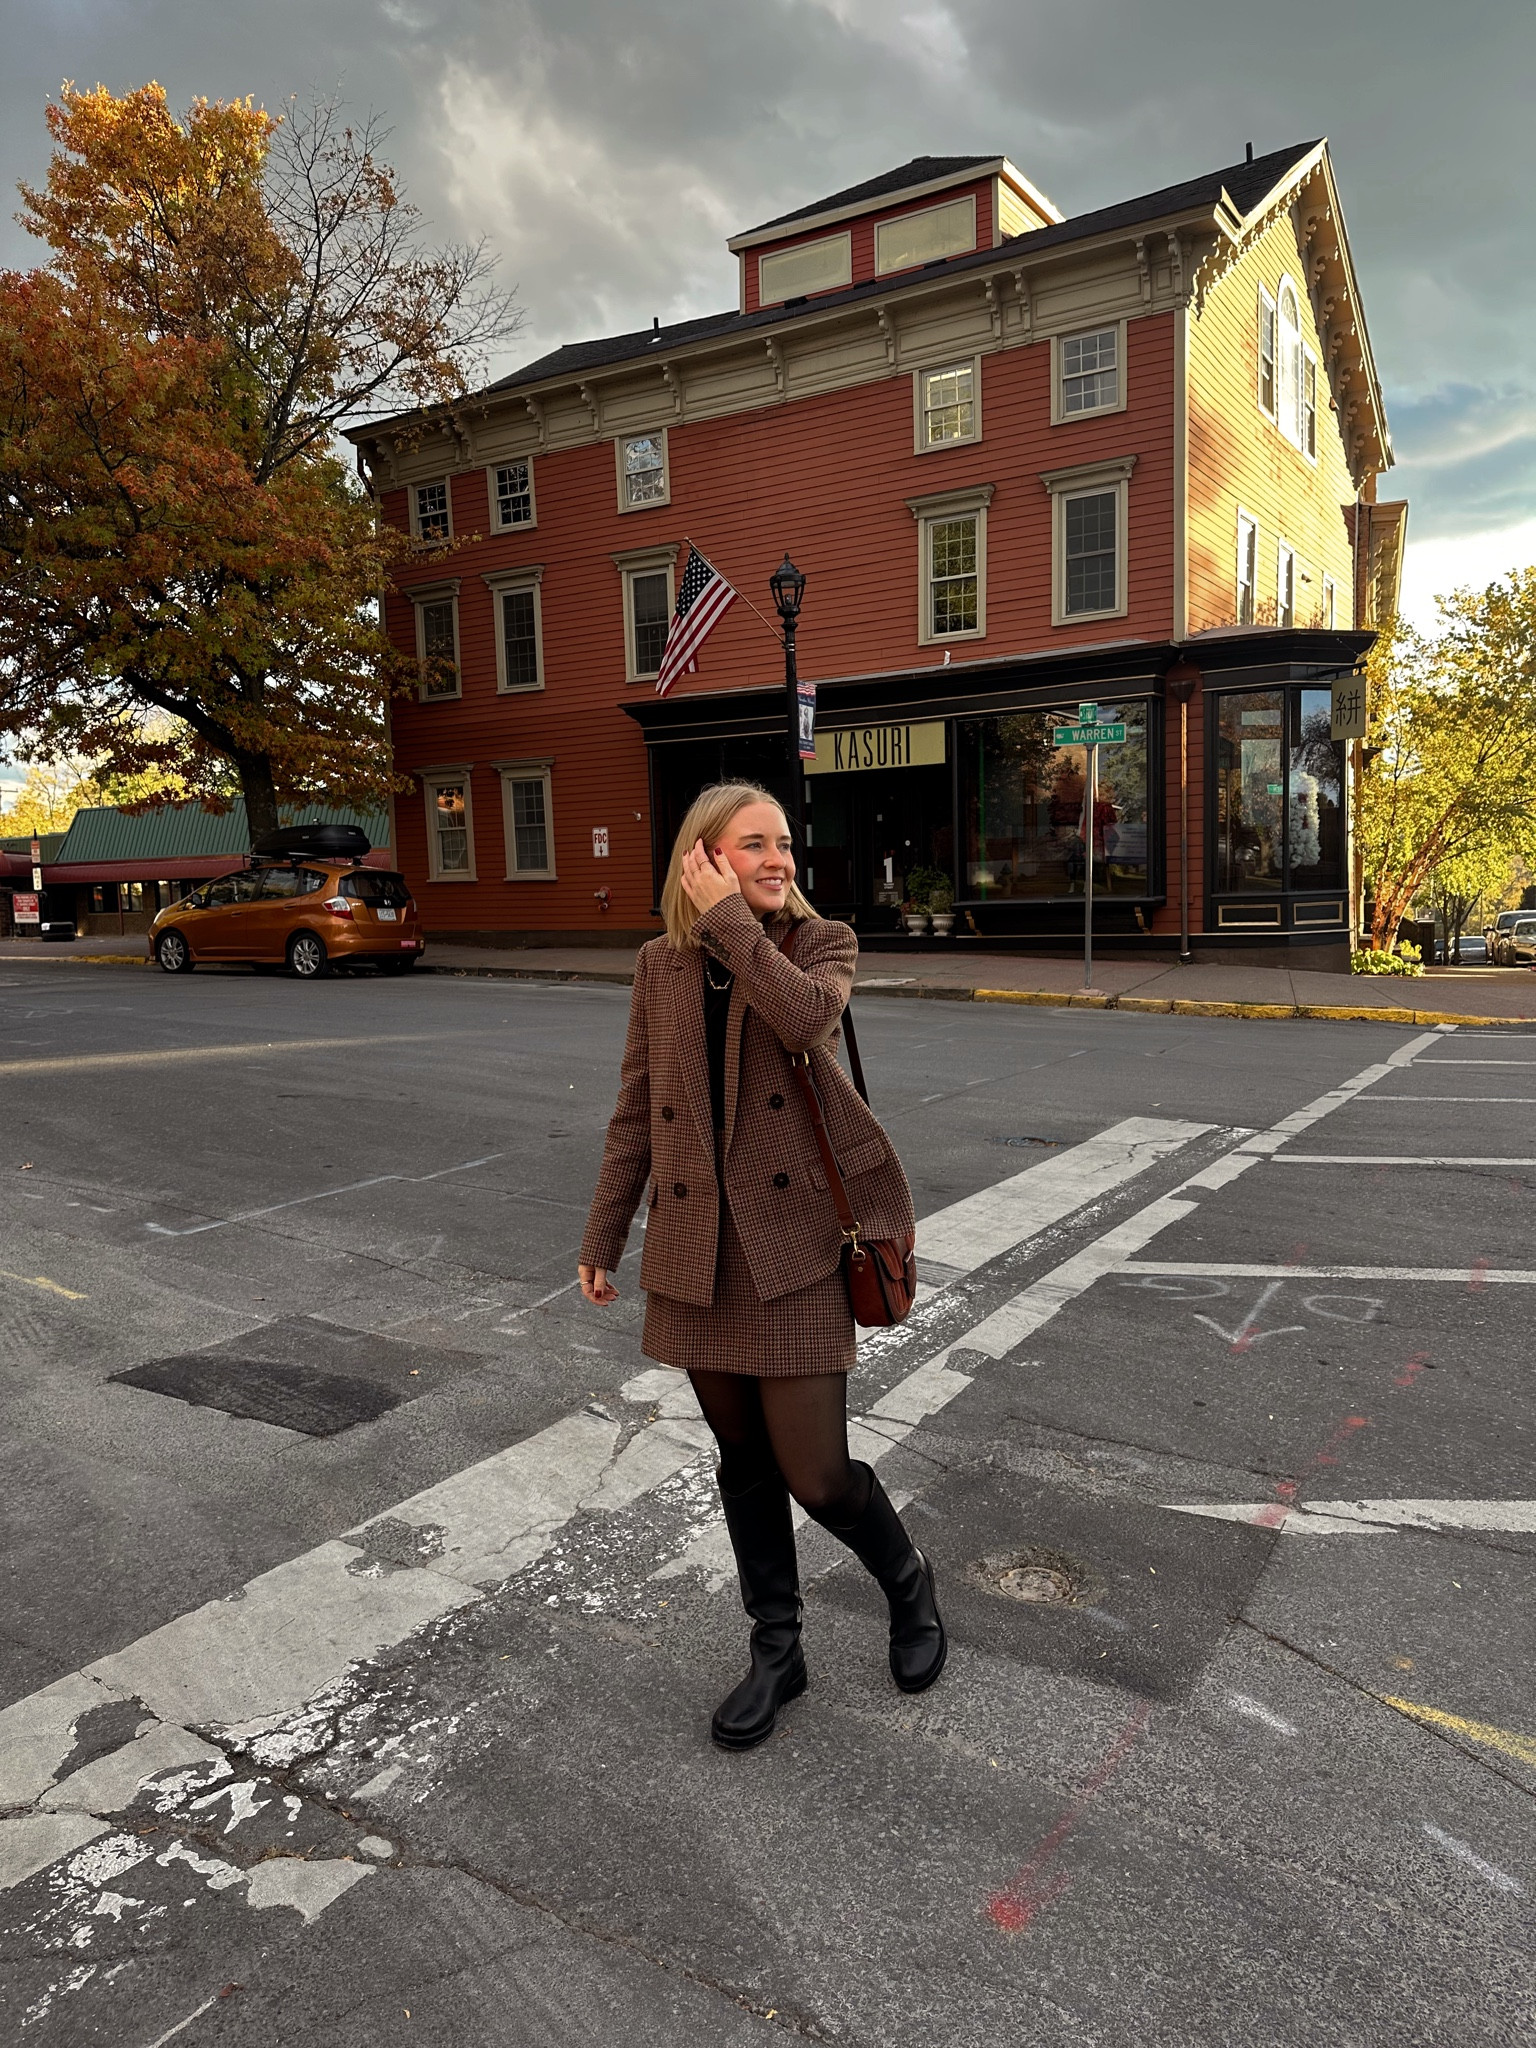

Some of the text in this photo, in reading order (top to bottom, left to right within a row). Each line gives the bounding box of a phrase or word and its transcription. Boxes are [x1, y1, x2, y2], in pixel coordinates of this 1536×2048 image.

[1071, 727, 1115, 741] WARREN
[834, 725, 911, 770] KASURI
[594, 833, 607, 844] FDC
[883, 856, 893, 883] 1
